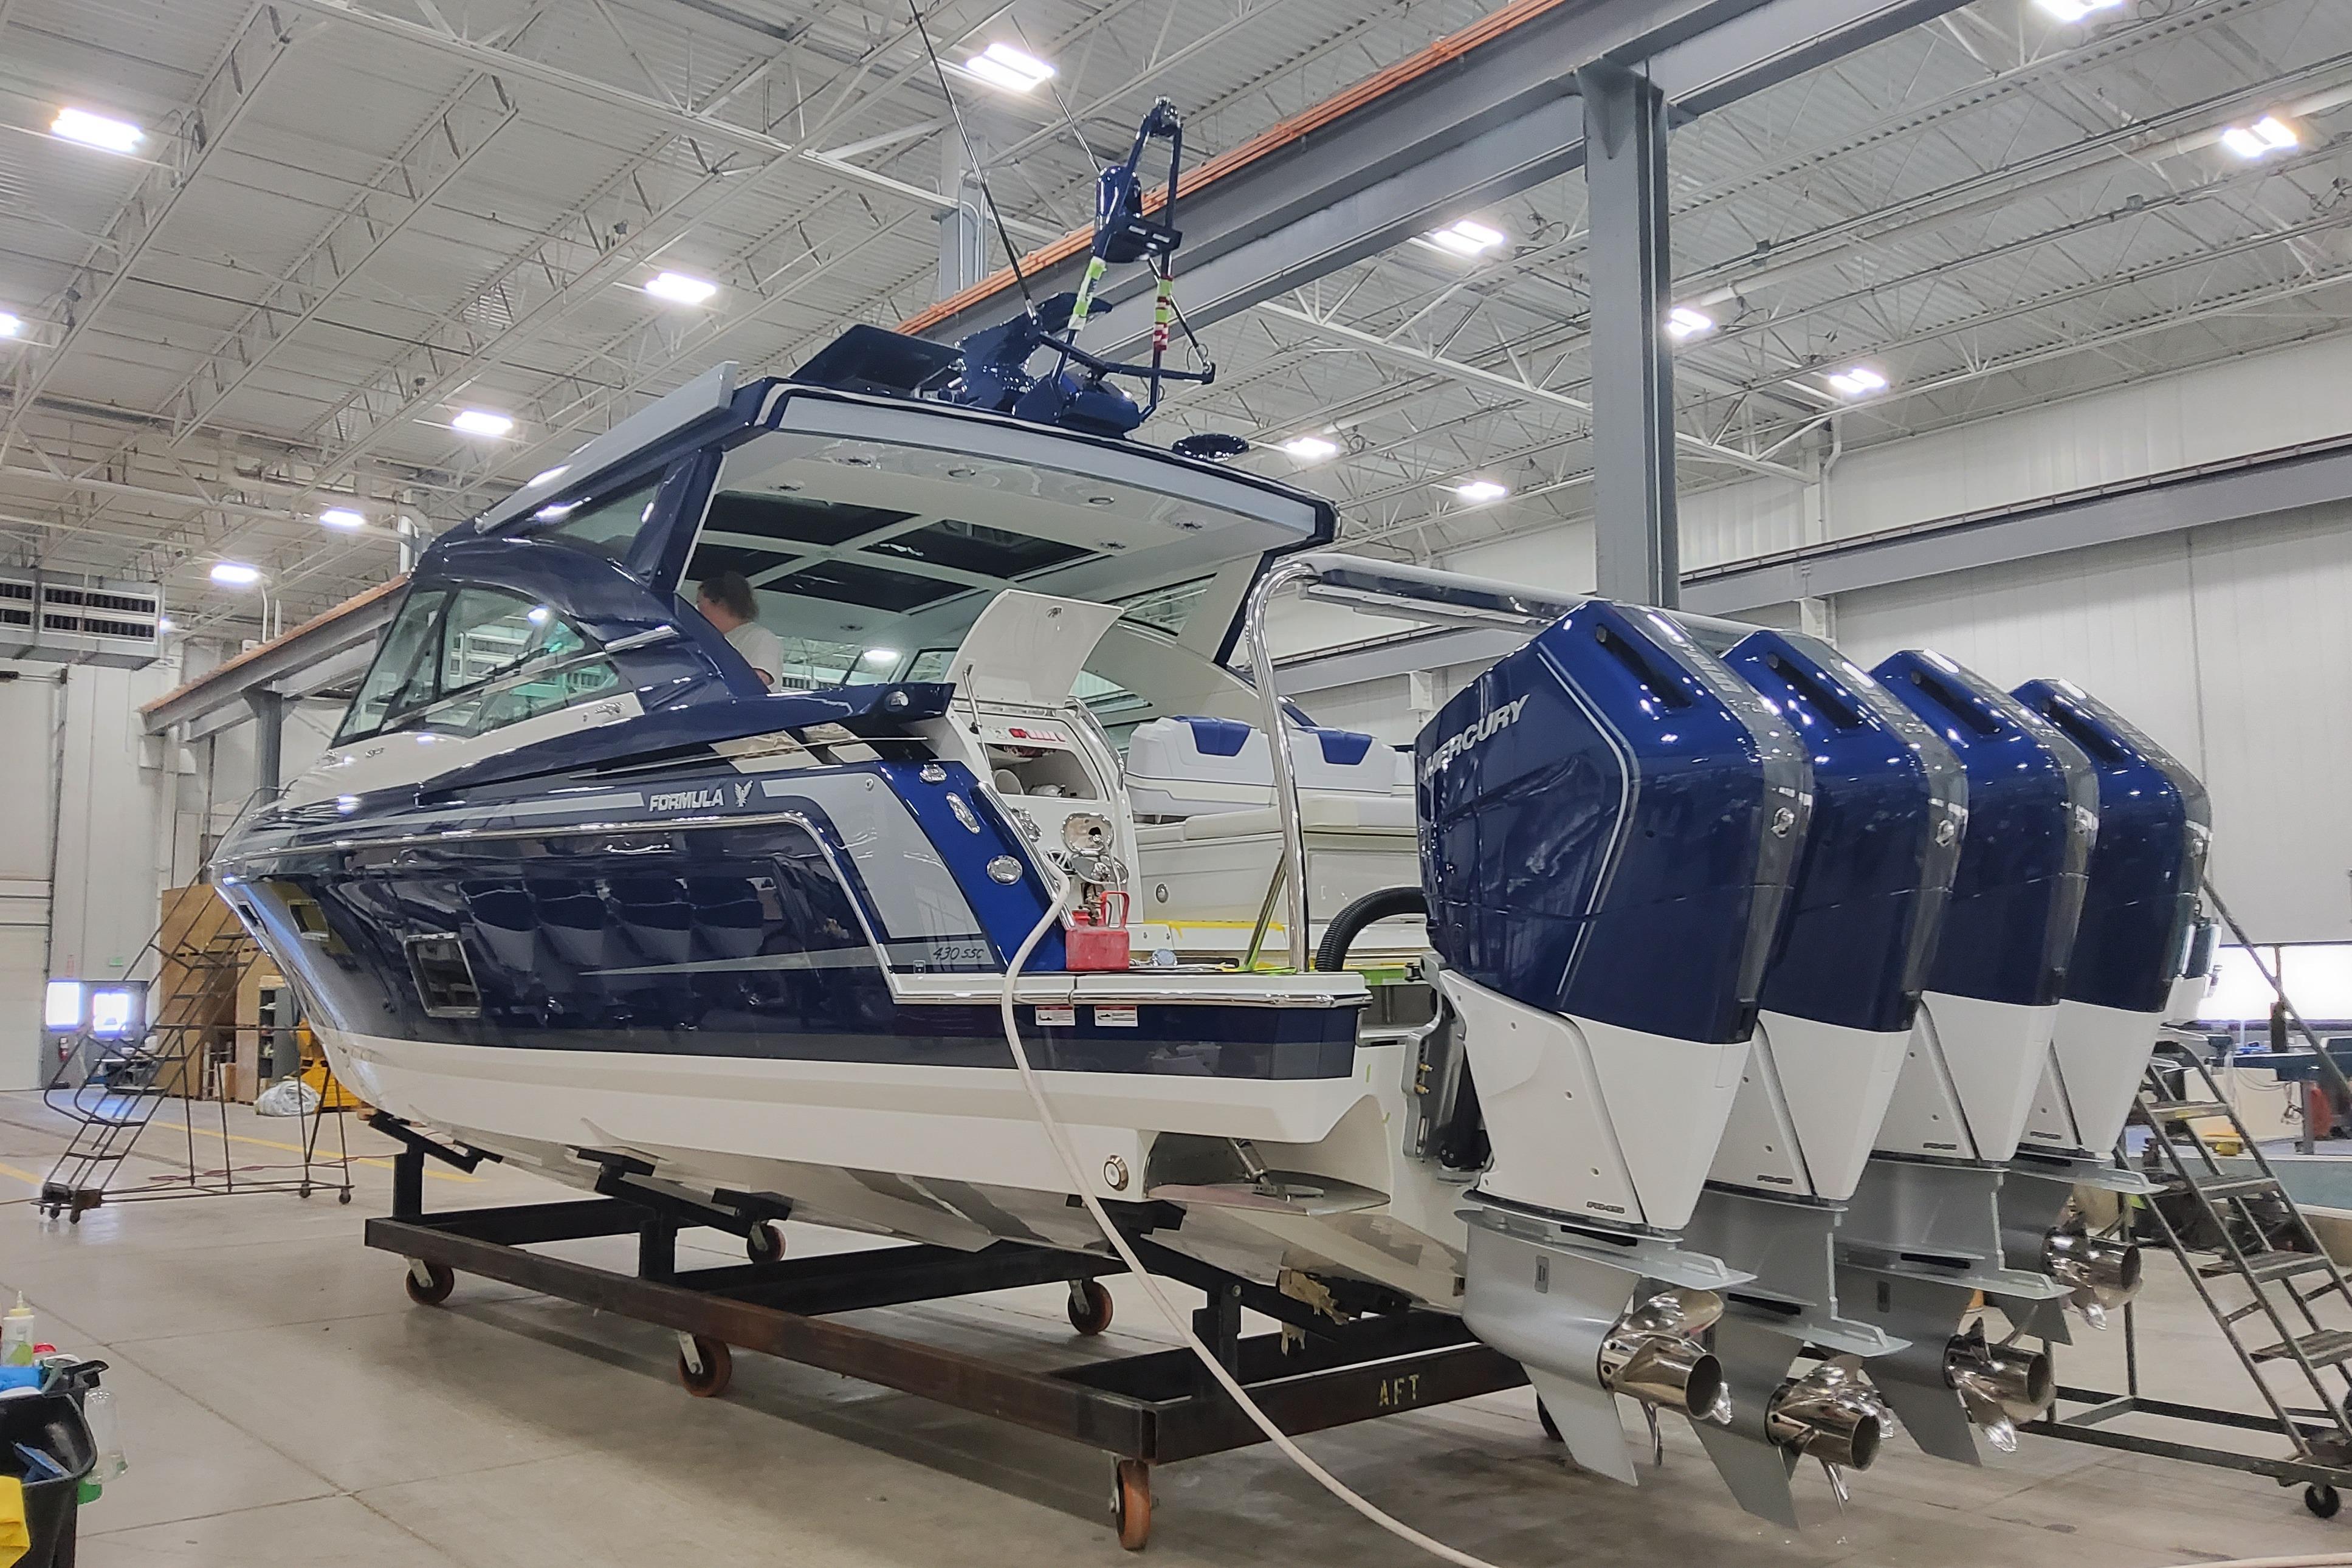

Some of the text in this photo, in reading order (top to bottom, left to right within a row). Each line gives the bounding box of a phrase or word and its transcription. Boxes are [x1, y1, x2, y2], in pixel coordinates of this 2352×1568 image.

[1423, 694, 1530, 781] MERCURY
[649, 788, 724, 812] FORMULA
[933, 947, 985, 960] 430 SSC
[1379, 1374, 1419, 1407] AFT
